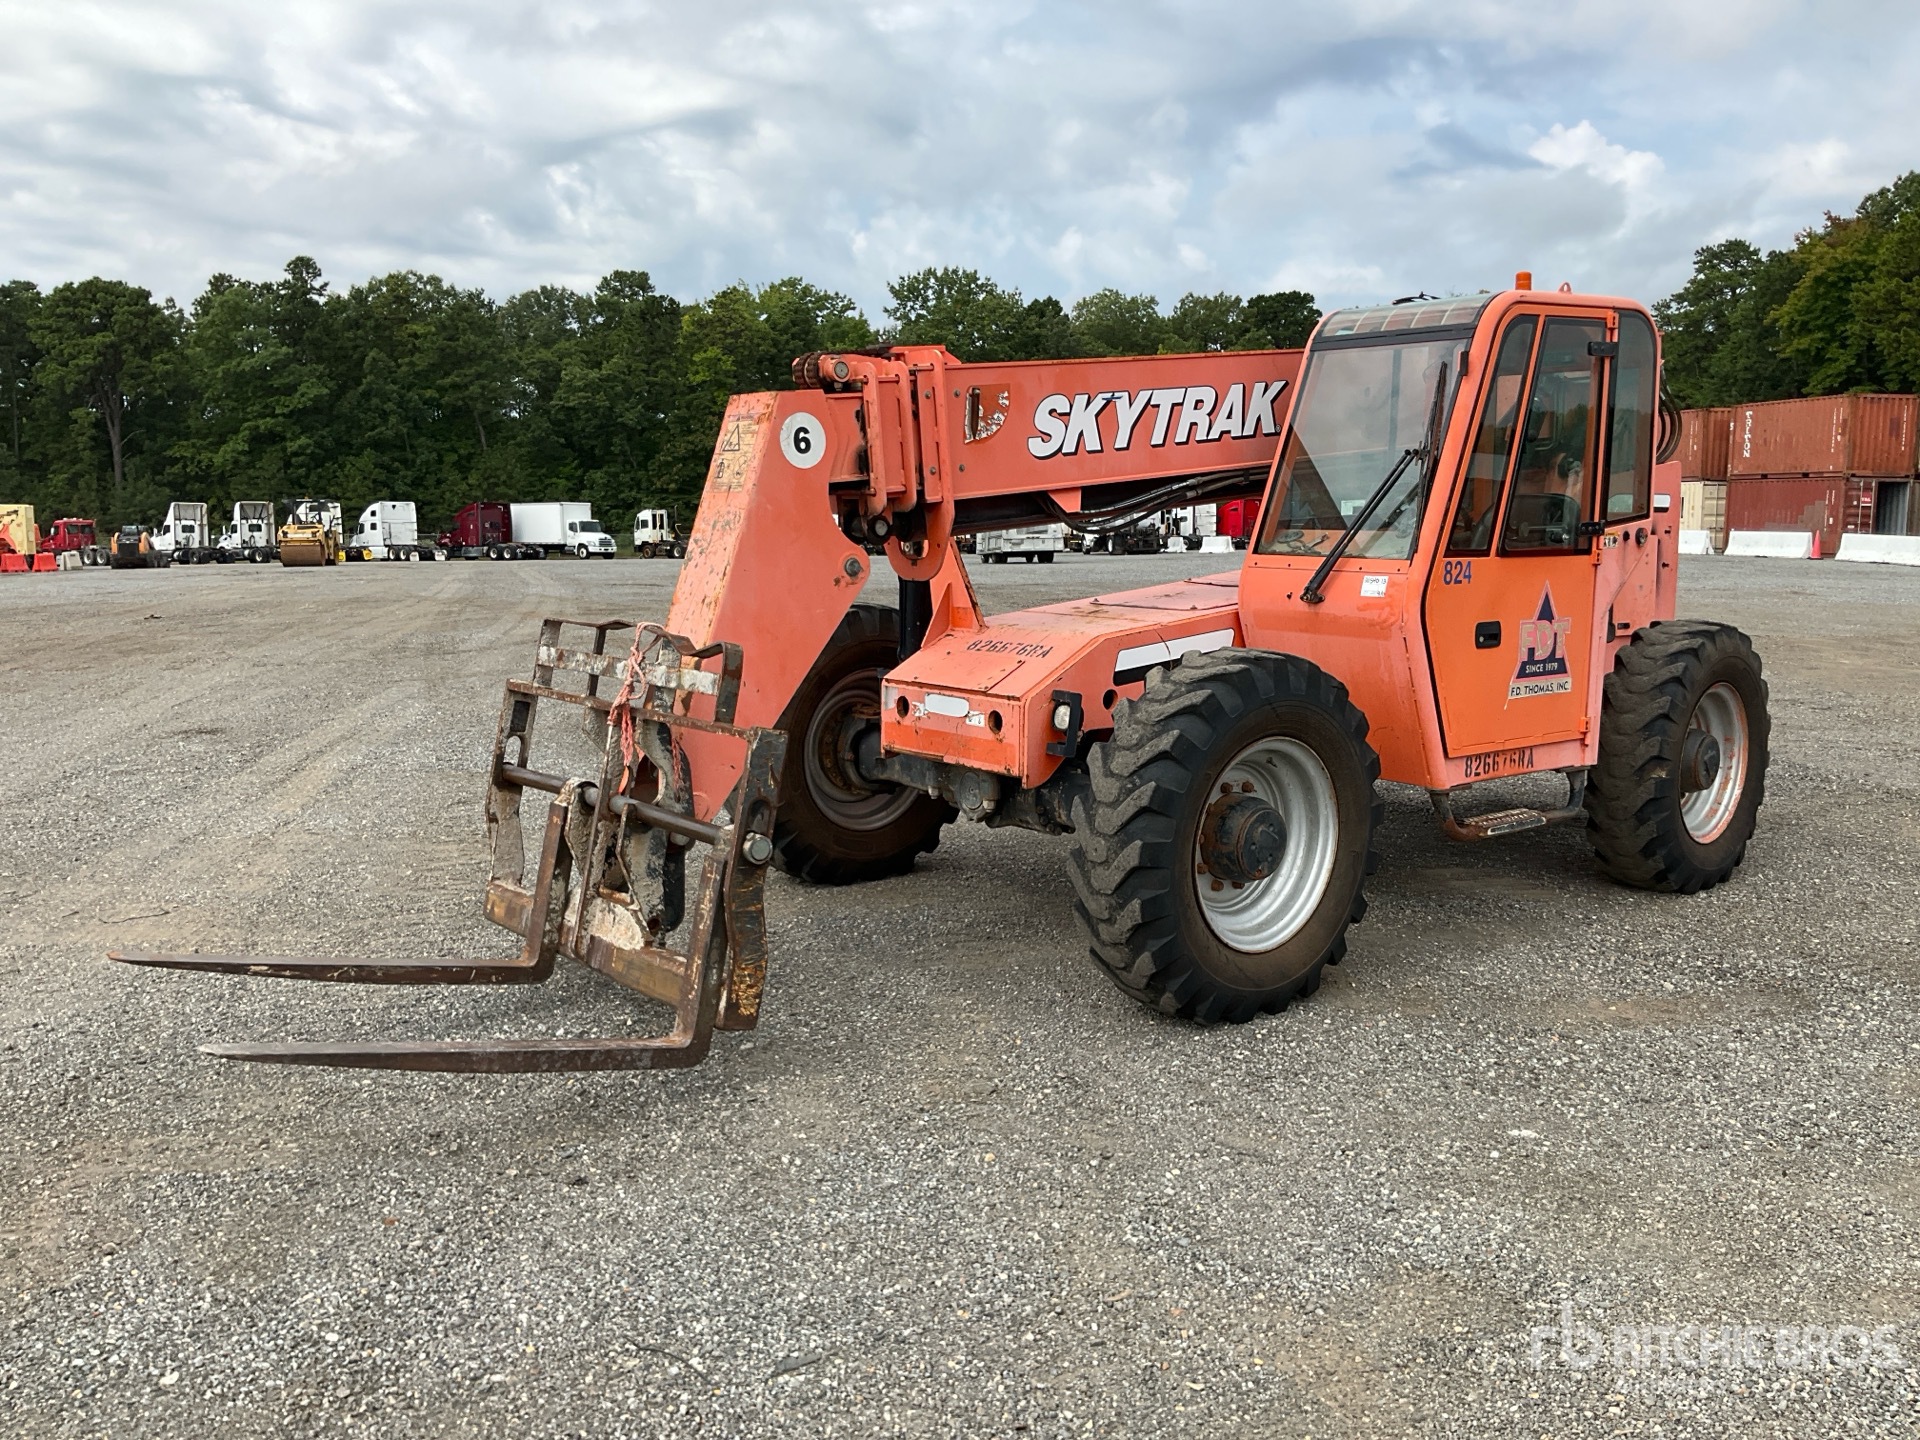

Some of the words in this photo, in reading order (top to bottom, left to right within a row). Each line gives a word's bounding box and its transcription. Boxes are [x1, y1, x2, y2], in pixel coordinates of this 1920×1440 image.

[1027, 380, 1289, 460] SKYTRAK
[1742, 410, 1754, 458] TRITON
[793, 426, 811, 455] 6
[1443, 560, 1472, 585] 824
[966, 639, 1054, 659] 826676RA
[1520, 619, 1571, 661] FDT
[1525, 663, 1544, 674] SINCE
[1545, 662, 1559, 672] 1979
[1464, 747, 1535, 778] 826676RA
